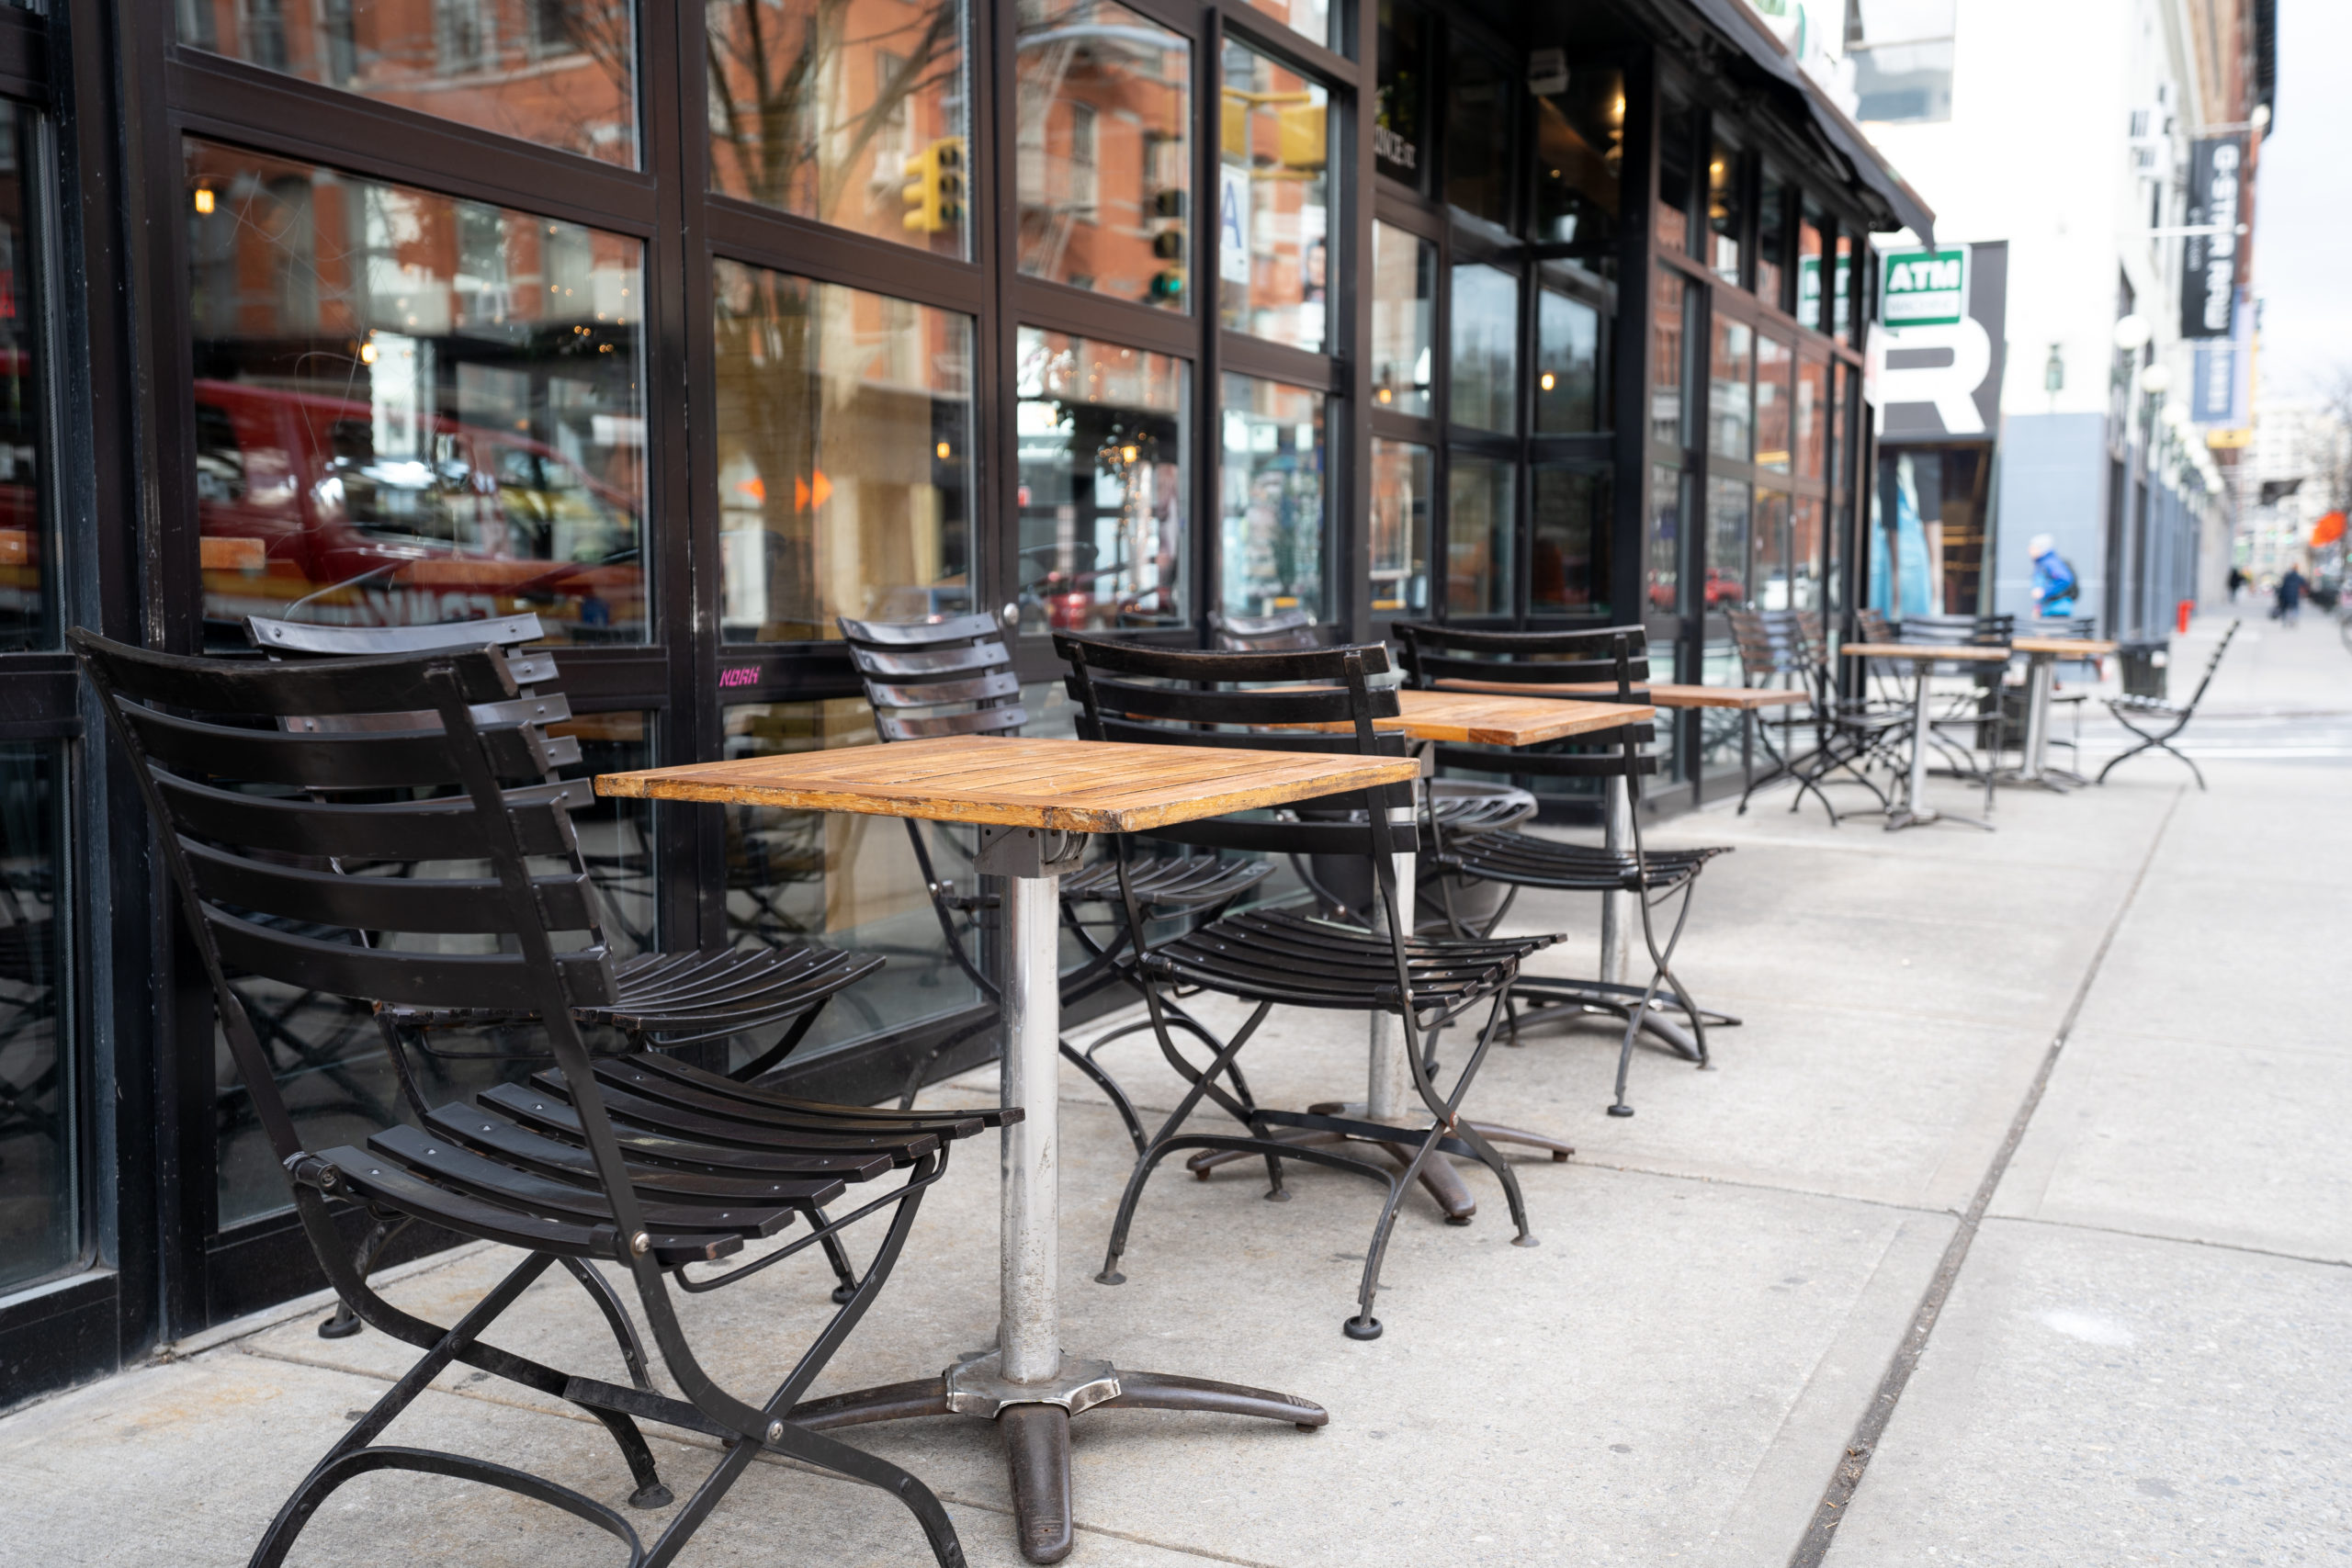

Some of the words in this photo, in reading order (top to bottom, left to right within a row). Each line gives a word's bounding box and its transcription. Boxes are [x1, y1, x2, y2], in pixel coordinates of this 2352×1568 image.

[1219, 180, 1242, 249] A
[1887, 259, 1961, 292] ATM
[1873, 315, 1991, 436] R
